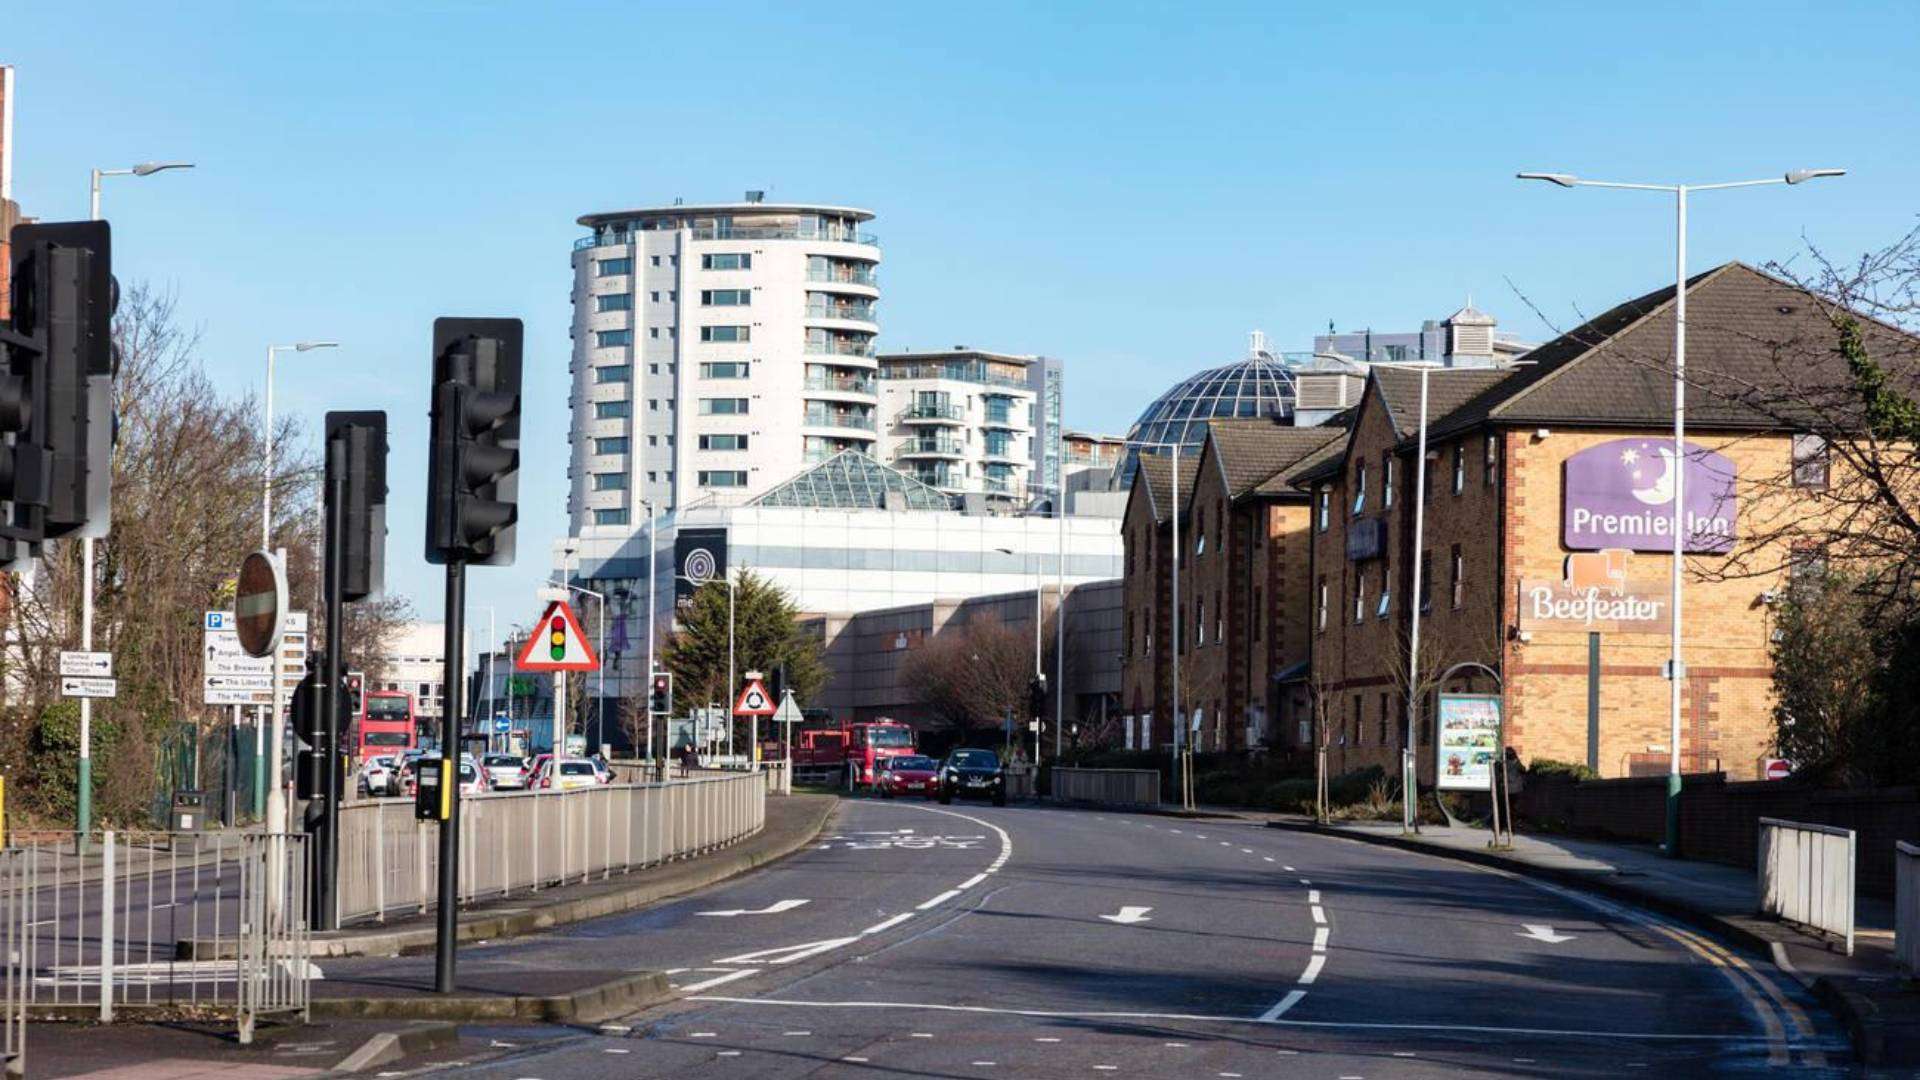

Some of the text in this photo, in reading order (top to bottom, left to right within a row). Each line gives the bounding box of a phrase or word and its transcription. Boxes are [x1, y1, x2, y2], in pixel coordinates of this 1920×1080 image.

[1687, 510, 1729, 536] Inn
[1529, 586, 1665, 626] Beefeater
[234, 664, 265, 672] Brewery
[241, 679, 268, 687] Liberty
[217, 692, 230, 700] The
[233, 692, 250, 700] Mall
